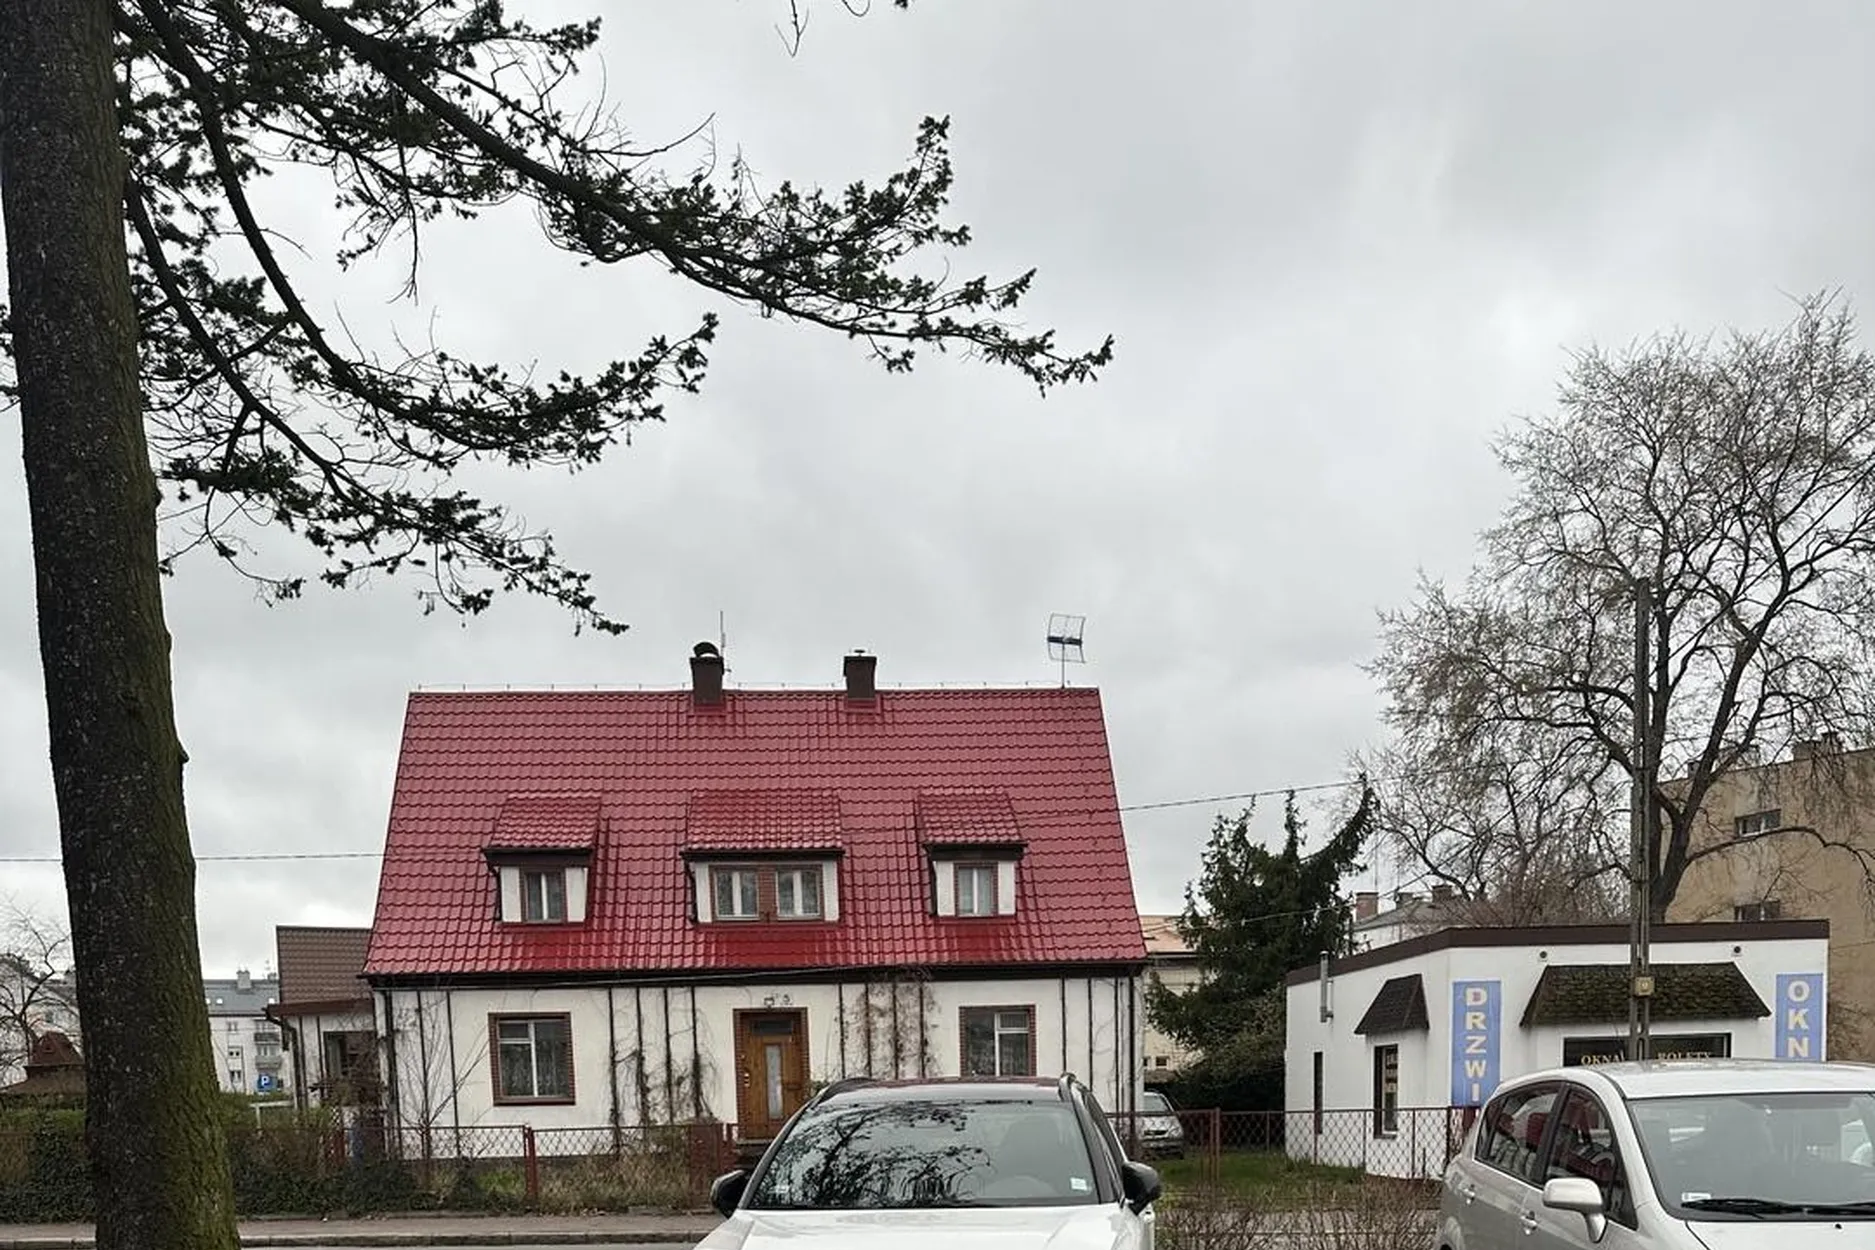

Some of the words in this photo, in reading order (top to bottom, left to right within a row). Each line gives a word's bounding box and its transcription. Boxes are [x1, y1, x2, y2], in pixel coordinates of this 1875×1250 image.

[1465, 987, 1488, 1102] DRZWI
[1580, 1054, 1620, 1066] OKNA
[261, 1075, 271, 1087] P
